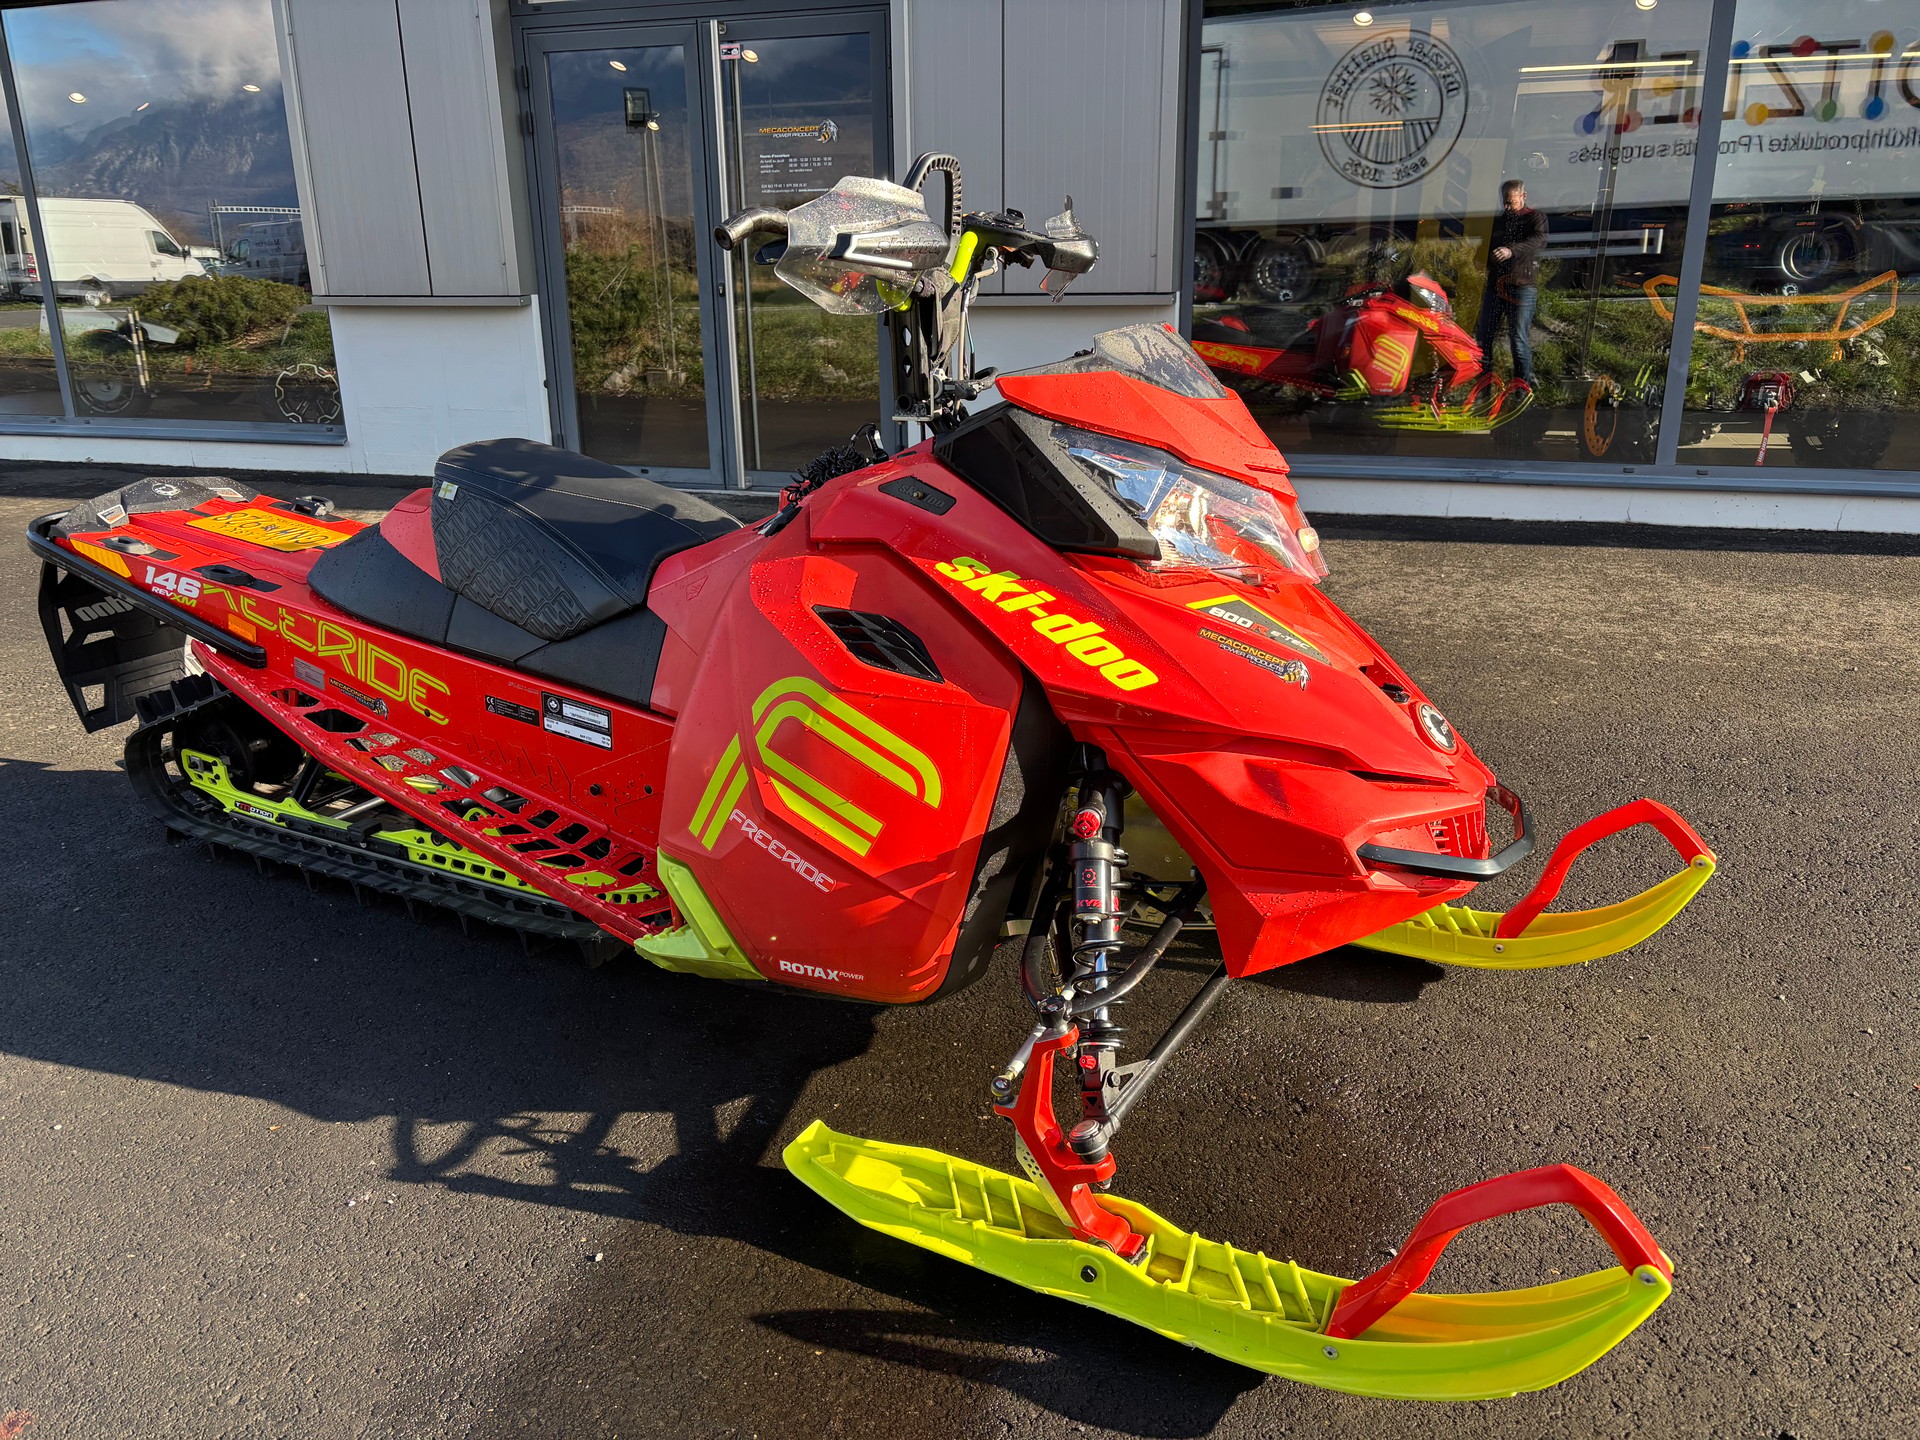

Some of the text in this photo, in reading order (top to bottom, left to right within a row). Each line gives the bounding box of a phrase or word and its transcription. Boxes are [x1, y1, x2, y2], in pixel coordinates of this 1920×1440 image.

[759, 125, 820, 134] MECACONCEPT
[145, 565, 201, 599] 146
[1199, 629, 1288, 667] MECACONCEPT
[1219, 643, 1246, 660] POWER
[1245, 654, 1284, 673] PRODUCTS
[329, 678, 376, 704] MECACONCEPT
[729, 809, 837, 893] FREERIDE
[779, 960, 865, 982] ROTAX POWER
